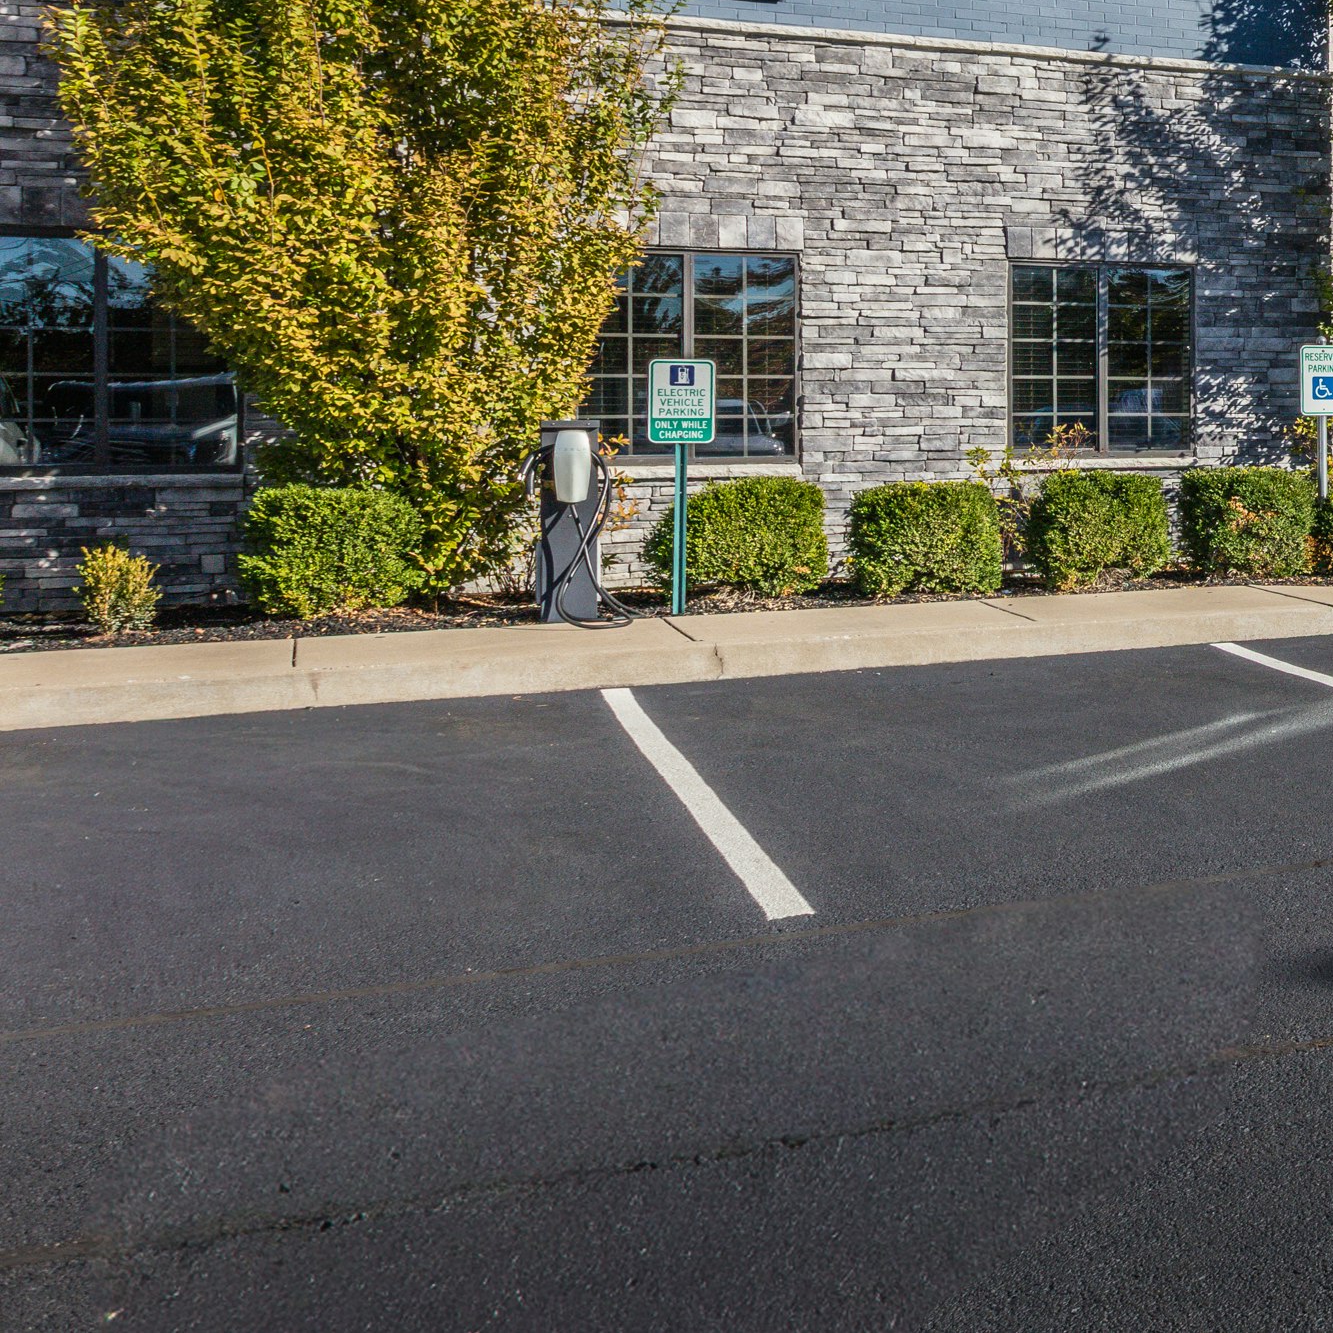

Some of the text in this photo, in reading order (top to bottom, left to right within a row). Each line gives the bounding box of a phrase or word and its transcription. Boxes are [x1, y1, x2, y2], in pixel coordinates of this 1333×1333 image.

[657, 388, 706, 397] ELECTRIC
[660, 398, 704, 406] VEHICLE
[659, 408, 705, 416] PARKING
[655, 420, 708, 429] ONLY WHILE
[659, 430, 704, 439] CHARGING
